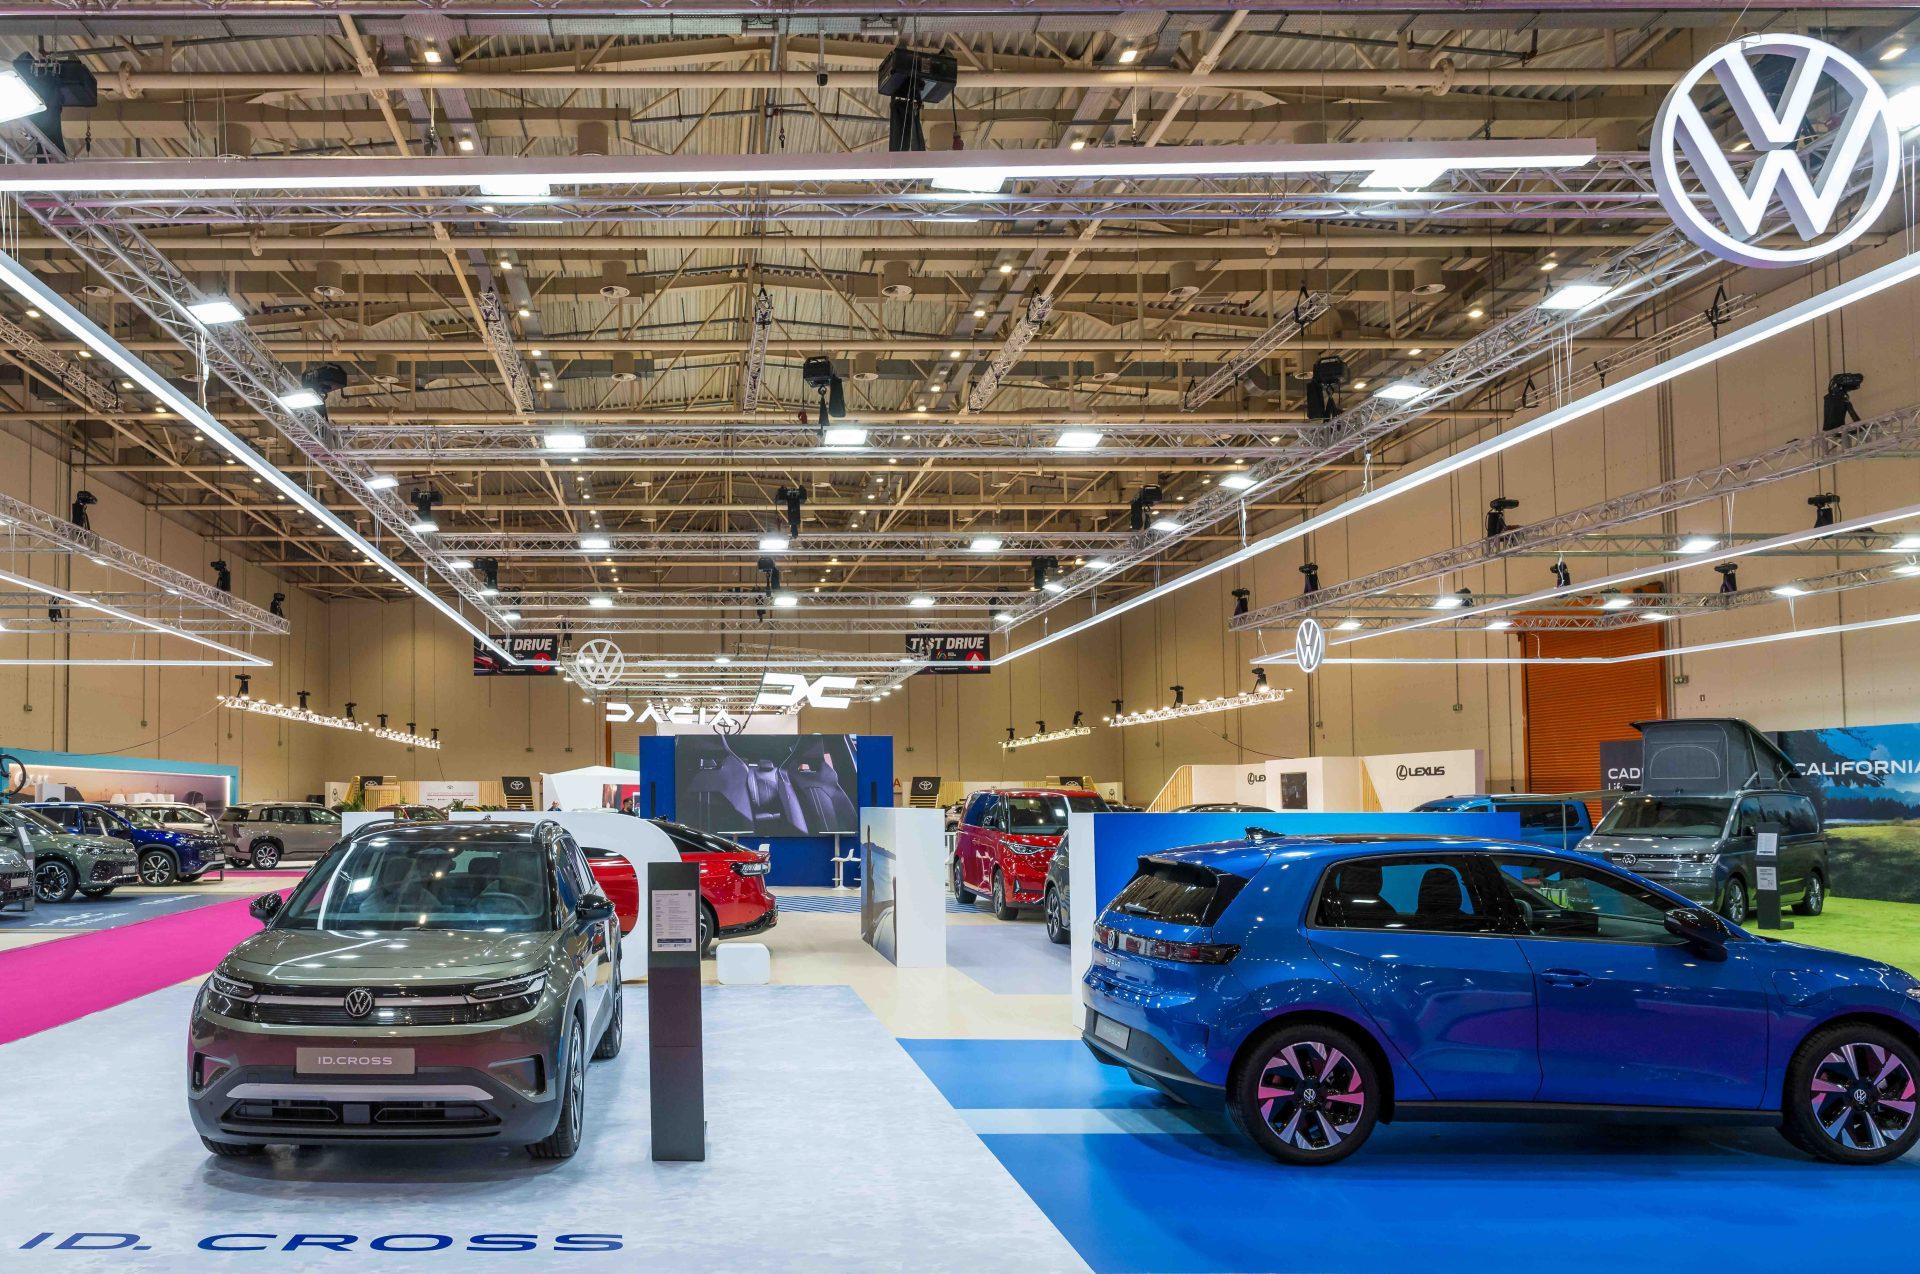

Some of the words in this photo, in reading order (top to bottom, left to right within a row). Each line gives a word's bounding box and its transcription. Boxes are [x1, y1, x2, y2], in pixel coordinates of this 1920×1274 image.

[514, 638, 553, 651] DRIVE
[946, 637, 984, 650] DRIVE
[606, 702, 735, 726] DACIA
[1409, 766, 1445, 776] LEXUS
[18, 1232, 152, 1250] ID.
[197, 1233, 624, 1252] CROSS
